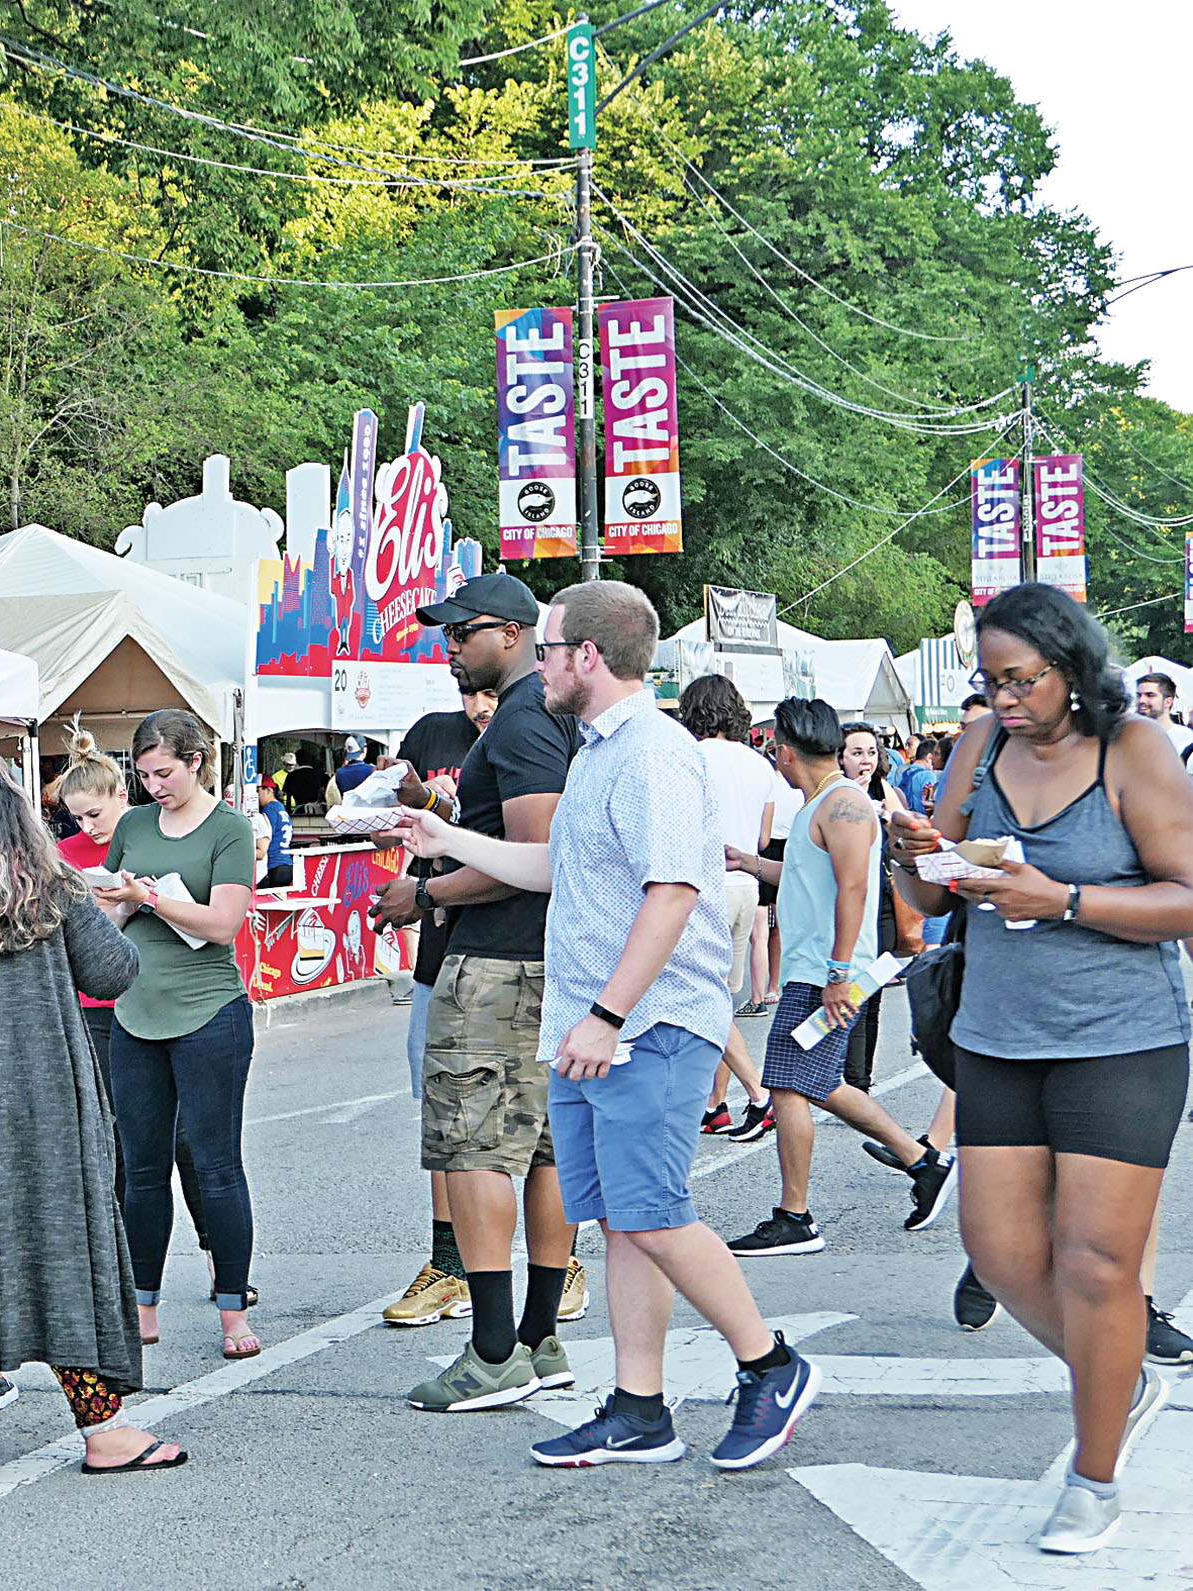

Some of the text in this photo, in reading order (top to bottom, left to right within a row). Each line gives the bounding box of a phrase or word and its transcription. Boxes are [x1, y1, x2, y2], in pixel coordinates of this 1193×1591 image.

[569, 36, 590, 135] C311
[578, 342, 591, 415] C311
[506, 322, 567, 476] TASTE
[607, 314, 670, 473] TASTE
[524, 484, 549, 495] GOOSE
[629, 481, 654, 491] GOOSE
[524, 507, 550, 520] ISLAND
[629, 503, 655, 516] ISLAND
[977, 466, 1016, 558] TASTE
[1040, 463, 1080, 556] TASTE
[503, 526, 573, 541] CITY OF CHICAGO
[608, 522, 679, 538] CITY OF CHICAGO
[334, 669, 347, 691] 20
